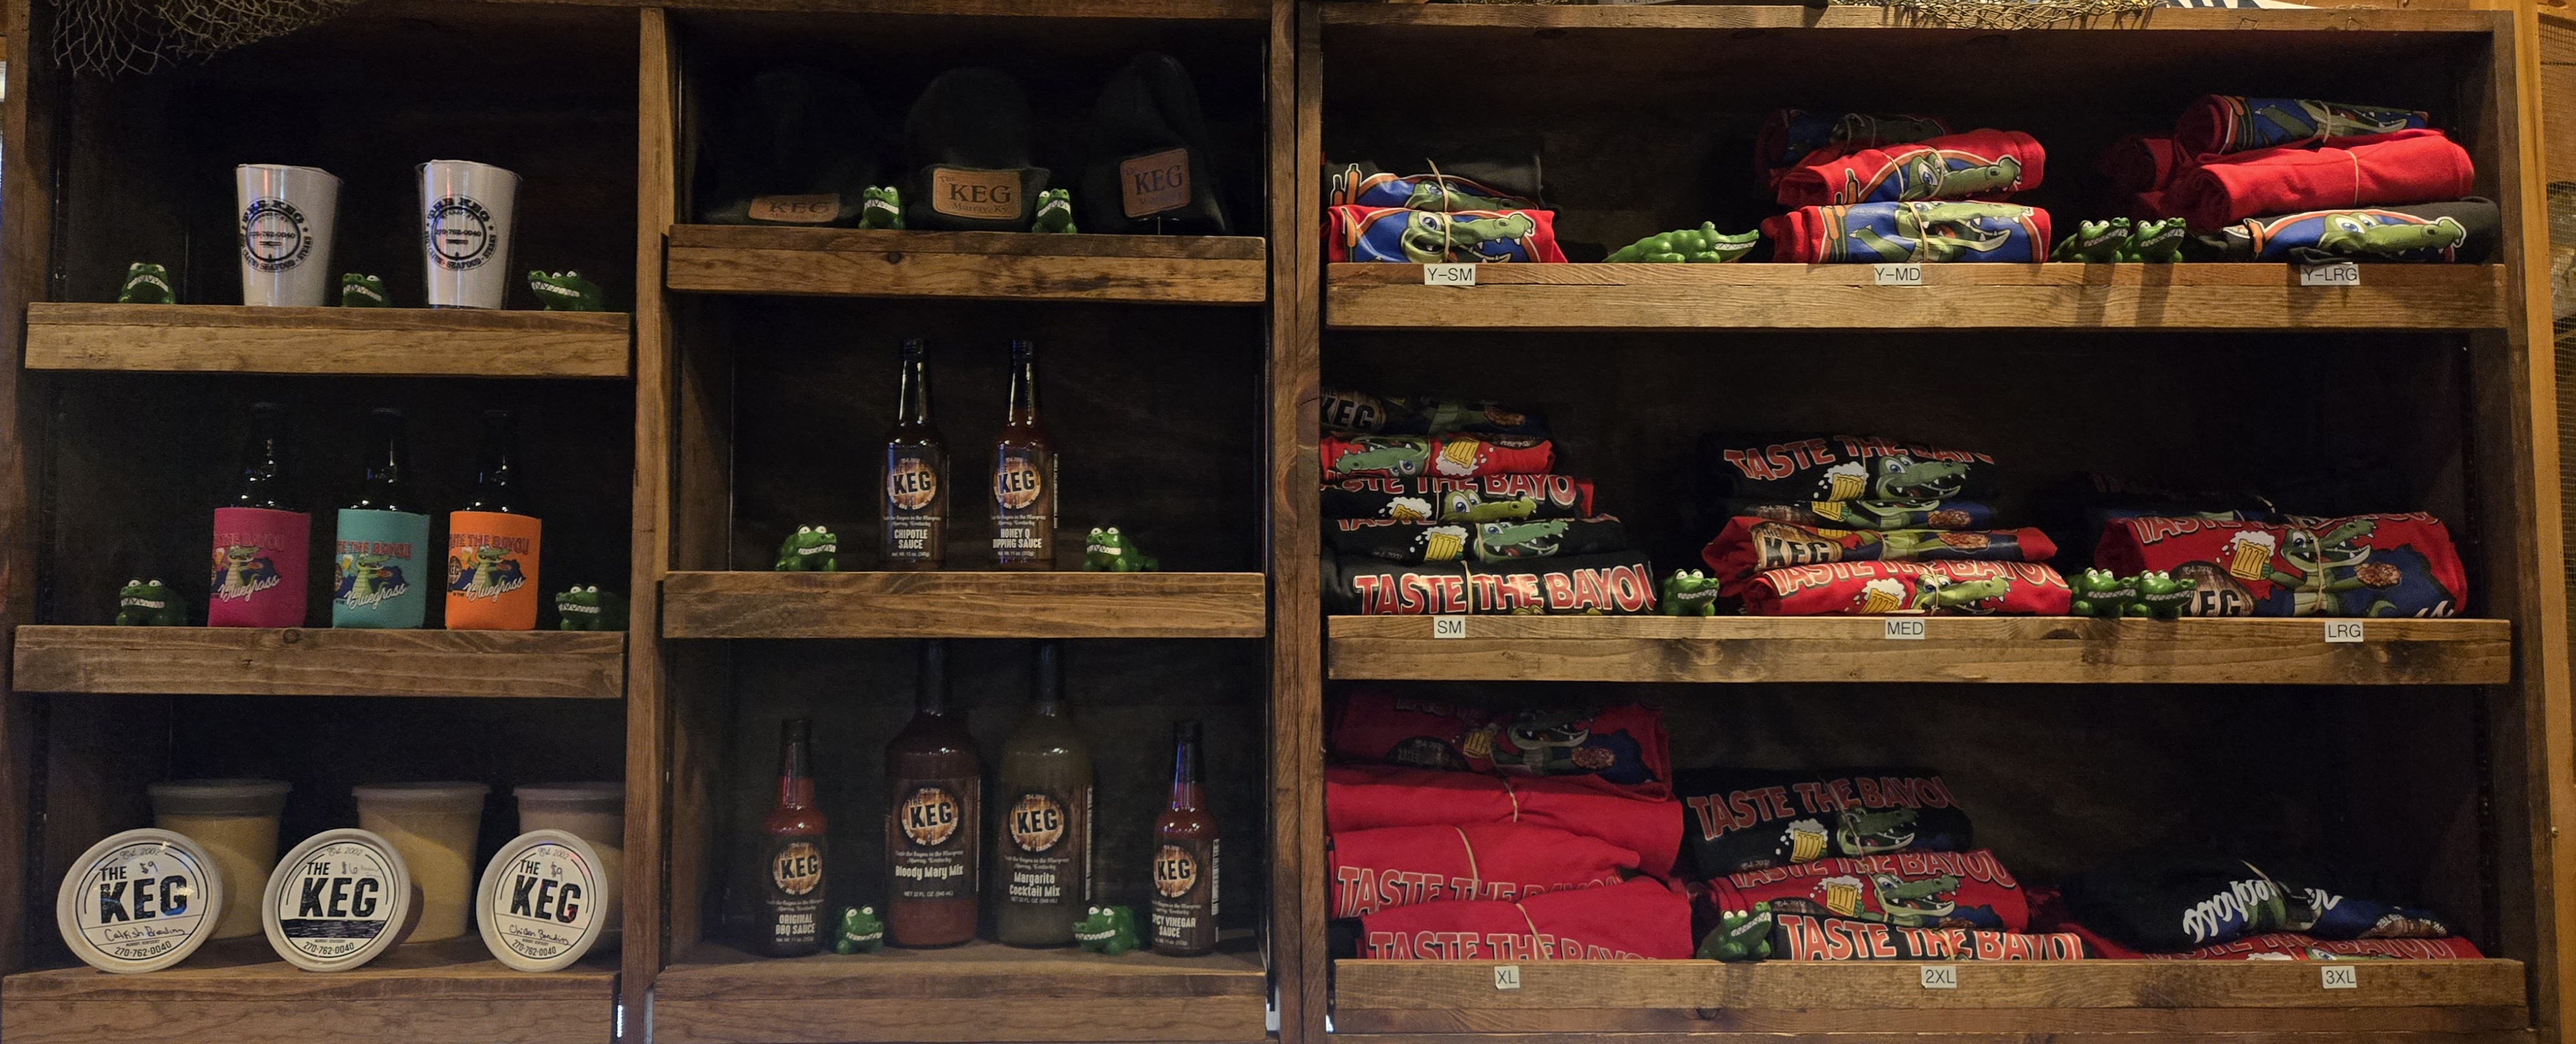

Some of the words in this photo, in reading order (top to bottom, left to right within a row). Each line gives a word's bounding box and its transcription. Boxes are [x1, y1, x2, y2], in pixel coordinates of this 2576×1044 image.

[1134, 164, 1183, 195] KEG
[948, 183, 1011, 204] KEG
[271, 199, 305, 224] KEG
[458, 197, 490, 222] KEG
[771, 201, 830, 214] KEG
[1428, 268, 1472, 282] Y-SM
[1874, 267, 1921, 283] Y-MD
[2304, 268, 2359, 282] Y-LRG
[1723, 438, 1837, 481] TASTE
[1833, 434, 1907, 458] THE
[893, 471, 931, 496] KEG
[998, 470, 1036, 494] KEG
[1485, 473, 1577, 509] BAYO
[894, 529, 928, 539] CHIPOTLE
[1000, 528, 1023, 538] HONEY
[1025, 528, 1031, 540] Q
[350, 541, 370, 553] THE
[898, 539, 924, 550] SAUCE
[1018, 538, 1042, 549] SAUCE
[1763, 536, 1830, 570] KEG
[1763, 561, 1875, 597] TASTE
[217, 574, 281, 603] Bluegrass
[343, 583, 408, 610] Bluegrass
[462, 576, 525, 603] Bluegrass
[1354, 572, 1468, 615] TASTE
[1470, 573, 1544, 611] THE
[1437, 621, 1462, 635] SM
[1887, 622, 1924, 635] MED
[2328, 624, 2361, 638] LRG
[910, 801, 952, 829] KEG
[1686, 785, 1795, 842] TASTE
[1792, 777, 1862, 814] THE
[1017, 809, 1058, 834] KEG
[99, 866, 127, 881] THE
[307, 862, 331, 875] THE
[520, 859, 541, 875] THE
[780, 854, 819, 879] KEG
[895, 865, 923, 881] Bloody
[924, 866, 948, 880] Mary
[948, 864, 964, 876] Mix
[1157, 858, 1191, 881] KEG
[1729, 860, 1828, 889] TASTE
[1835, 853, 1900, 877] THE
[1900, 848, 2017, 889] BAYOU
[1013, 872, 1055, 887] Margarita
[298, 877, 379, 917] KEG
[510, 874, 581, 923] KEG
[1009, 884, 1043, 897] Cocktail
[1044, 885, 1061, 897] Mix
[1338, 866, 1443, 919] TASTE
[1450, 877, 1516, 902] THE
[100, 875, 187, 924] KEG
[779, 913, 813, 925] ORIGINAL
[1165, 915, 1197, 928] VINEGAR
[775, 924, 791, 936] BBQ
[792, 923, 816, 934] SAUCE
[1159, 925, 1181, 938] SAUCE
[1777, 914, 1898, 960] TASTE
[1896, 926, 1973, 959] THE
[114, 940, 172, 957] 270-762-0040
[303, 941, 355, 955] 270-762-0040
[512, 939, 556, 956] 270-762-0040
[1369, 931, 1480, 960] TASTE
[1486, 933, 1555, 960] THE
[1496, 970, 1517, 984] XL
[1925, 969, 1955, 984] 2XL
[2326, 969, 2356, 984] 3XL
